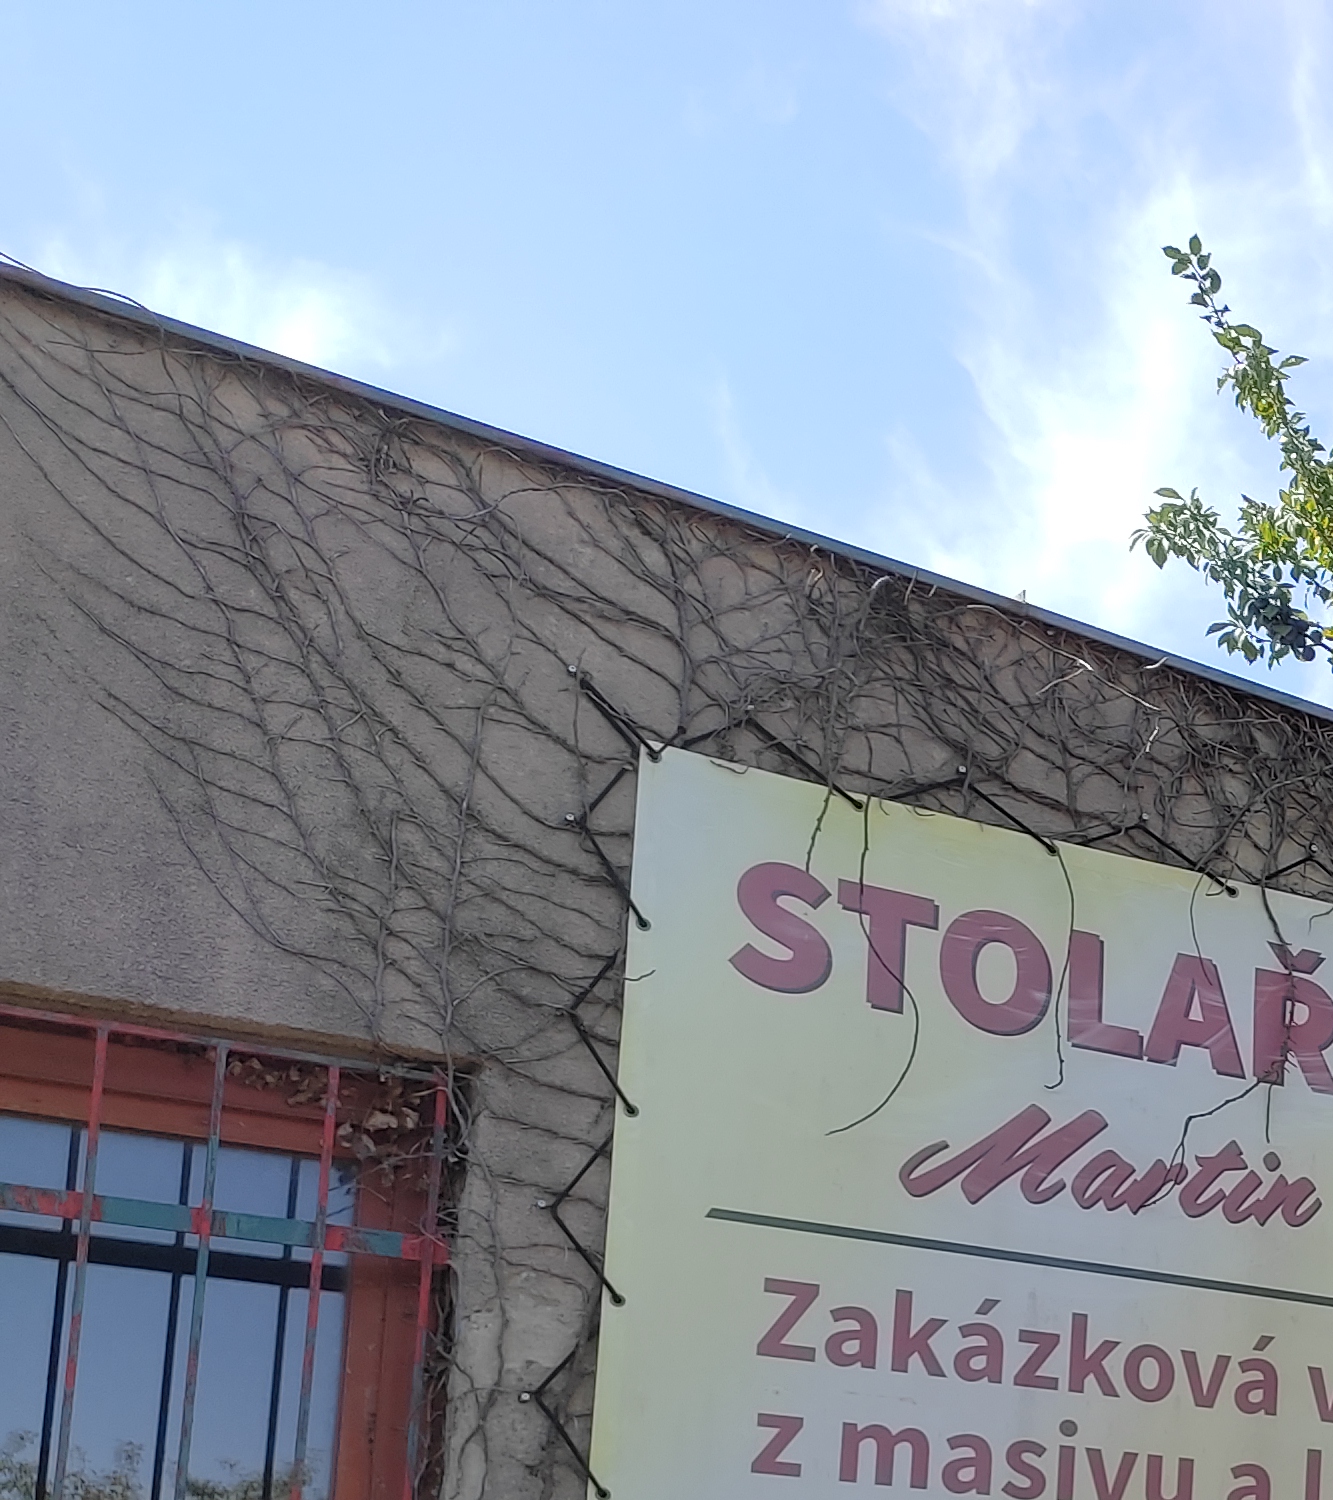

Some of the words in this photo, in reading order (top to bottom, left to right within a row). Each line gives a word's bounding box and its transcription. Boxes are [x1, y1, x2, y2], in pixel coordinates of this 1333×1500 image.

[899, 1103, 1322, 1227] Martin
[755, 1277, 1280, 1418] Zakázková
[751, 1412, 804, 1477] z
